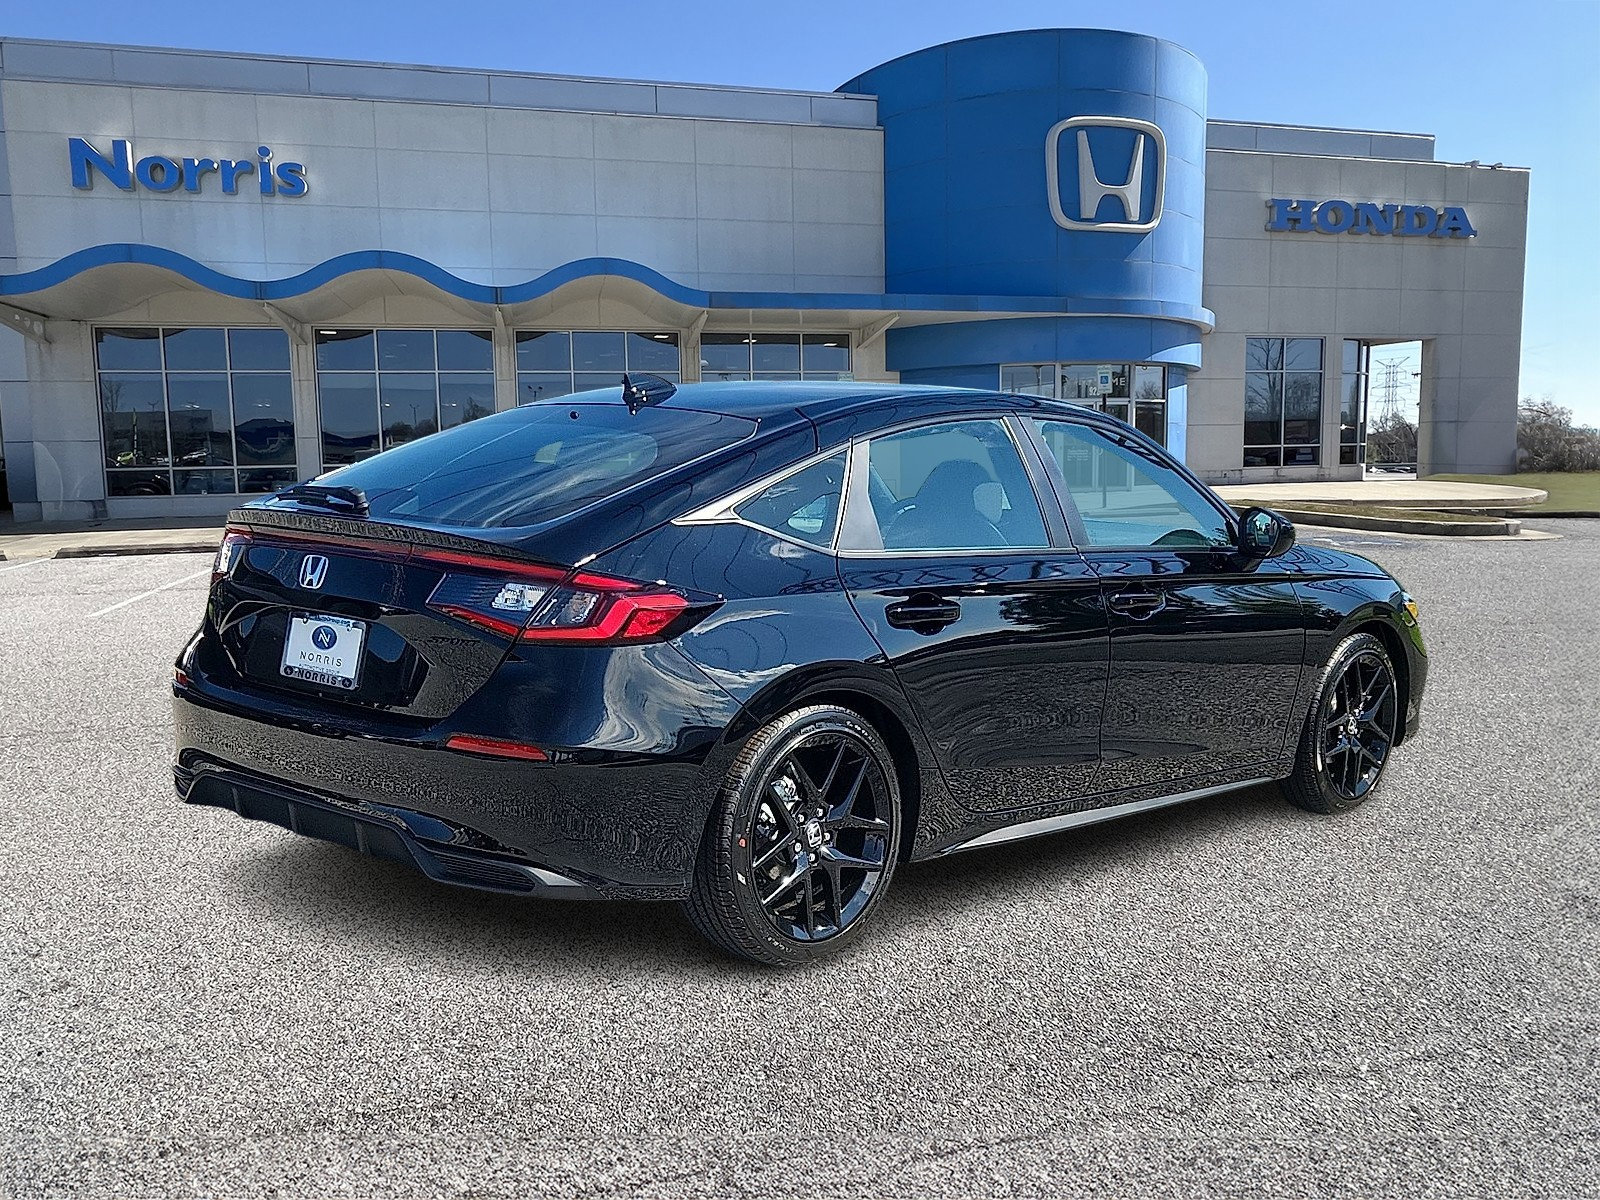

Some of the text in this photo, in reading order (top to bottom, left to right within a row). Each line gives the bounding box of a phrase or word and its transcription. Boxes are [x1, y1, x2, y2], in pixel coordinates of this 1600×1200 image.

[68, 137, 309, 197] Norris
[1266, 198, 1478, 239] HONDA
[299, 651, 342, 667] NORRIS
[297, 669, 337, 686] NORRIS
